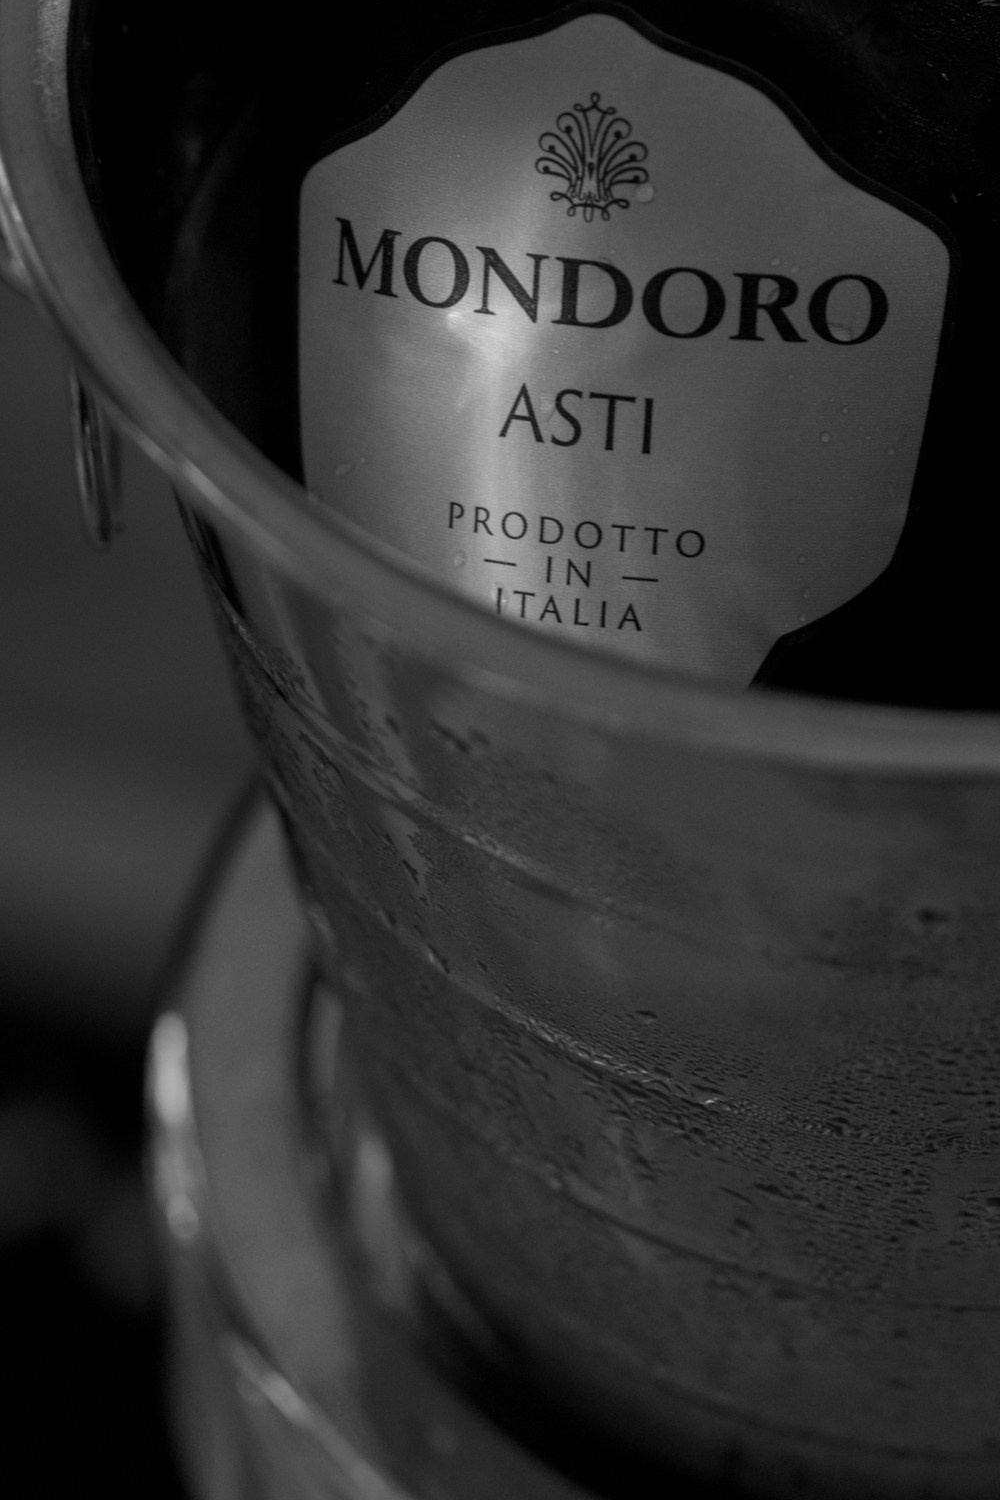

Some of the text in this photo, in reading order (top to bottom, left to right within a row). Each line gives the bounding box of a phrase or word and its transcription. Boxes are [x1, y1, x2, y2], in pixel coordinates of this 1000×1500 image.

[332, 216, 889, 346] MONDORO
[498, 382, 655, 455] ASTI
[447, 501, 707, 559] PRODOTTO
[545, 555, 593, 589] IN
[494, 587, 643, 633] ITALIA
